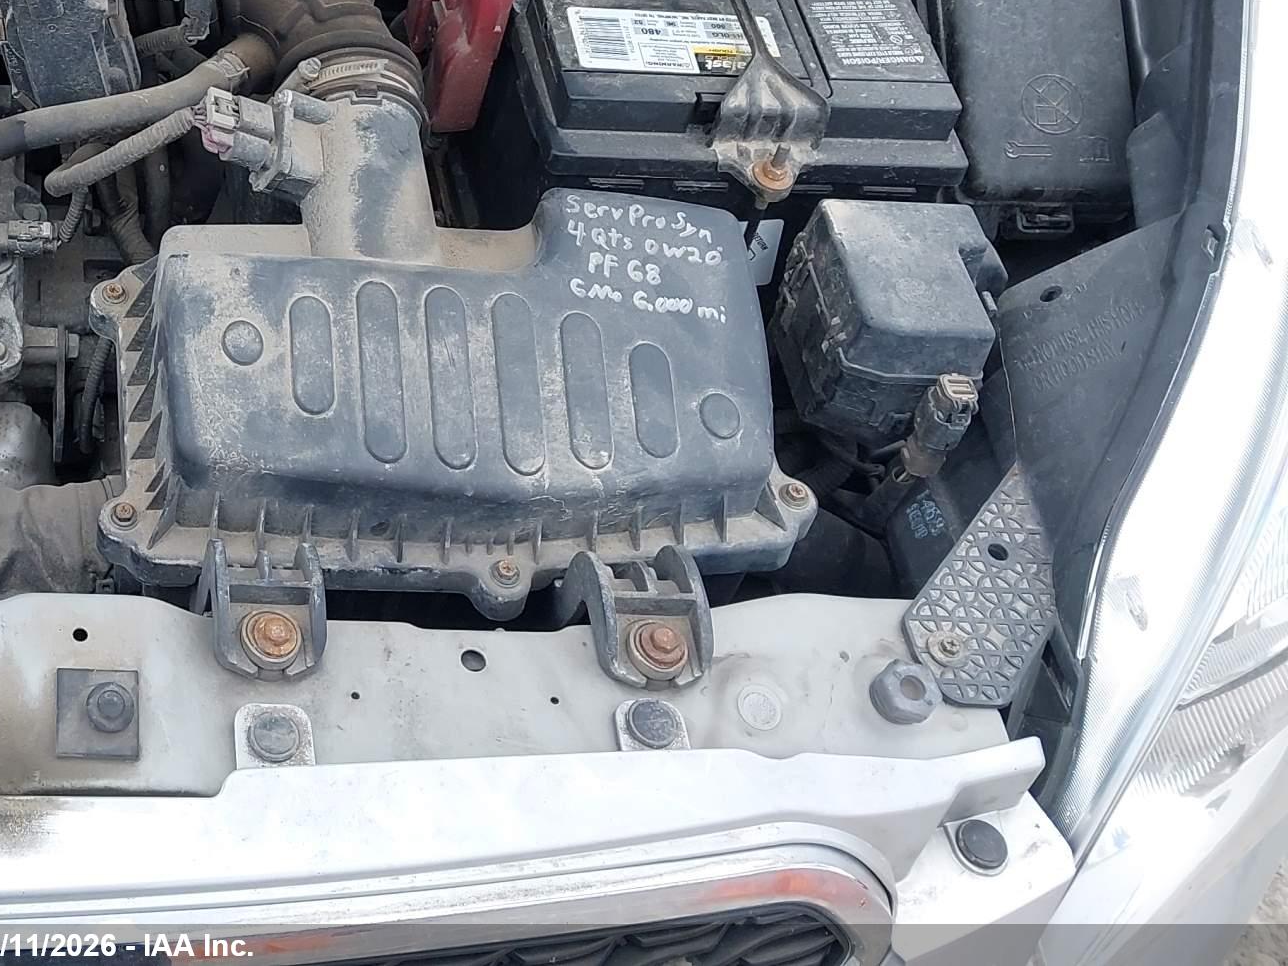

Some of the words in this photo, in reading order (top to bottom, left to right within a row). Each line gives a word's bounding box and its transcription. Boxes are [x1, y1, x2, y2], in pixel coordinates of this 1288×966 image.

[567, 219, 587, 247] 4
[591, 227, 633, 251] Qts
[697, 305, 727, 324] mi
